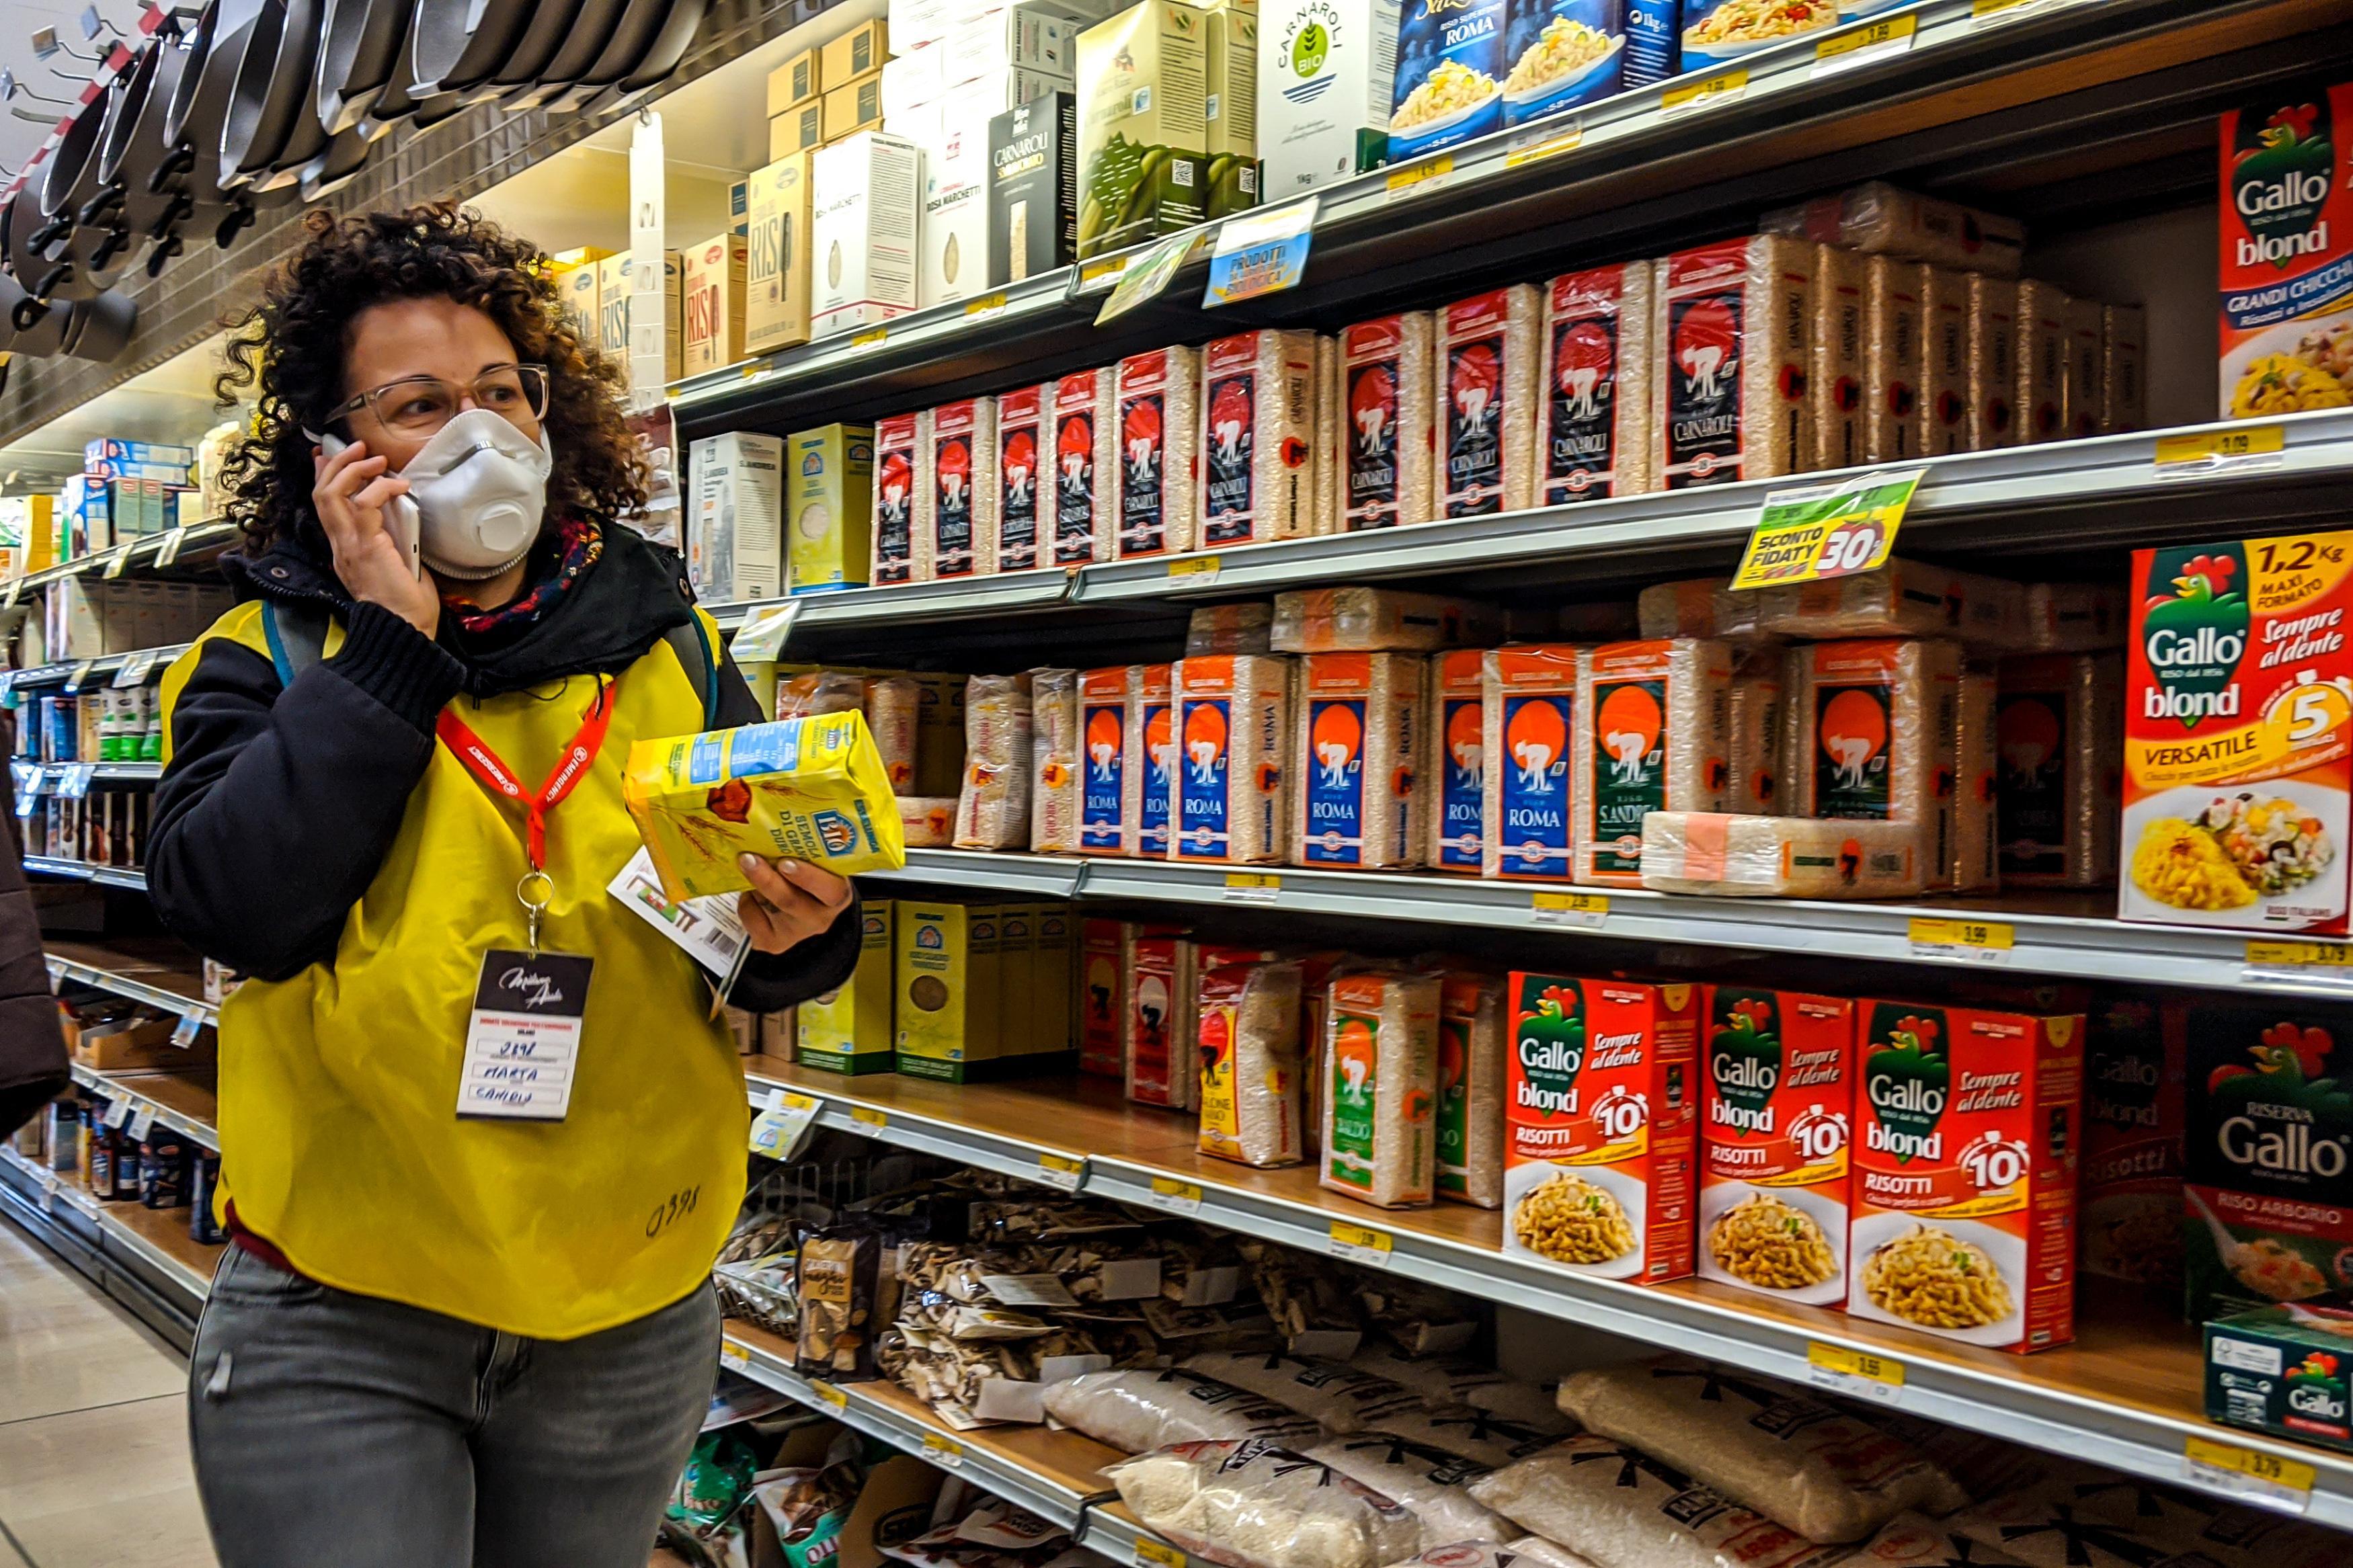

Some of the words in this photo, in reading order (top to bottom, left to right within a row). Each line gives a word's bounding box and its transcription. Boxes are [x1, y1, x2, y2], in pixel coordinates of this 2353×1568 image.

[1278, 2, 1343, 69] CARNAROLI
[1445, 16, 1494, 46] ROMA
[1298, 54, 1323, 73] BIO
[994, 132, 1048, 167] CARNAROLI
[2237, 171, 2327, 215] Gallo
[2236, 220, 2327, 267] blond
[2227, 286, 2288, 313] GRANDI
[1749, 542, 1819, 568] FIDATY
[1757, 526, 1824, 551] SCONTO
[2257, 540, 2316, 575] 1,2
[2258, 578, 2323, 608] FORMATO
[2259, 574, 2303, 594] MAXI
[2260, 608, 2344, 644] Sempre
[2147, 626, 2243, 667] Gallo
[2259, 641, 2281, 669] al
[2281, 632, 2344, 664] dente
[2145, 683, 2240, 718] blond
[2288, 690, 2330, 740] 5
[1265, 706, 1275, 751] ROMA
[1400, 707, 1410, 754] ROMA
[2145, 731, 2258, 766] VERSATILE
[545, 758, 580, 803] EMERGENCY
[780, 811, 793, 826] DI
[1087, 795, 1117, 810] ROMA
[1185, 798, 1222, 815] ROMA
[1312, 802, 1355, 819] ROMA
[1509, 809, 1561, 828] ROMA
[770, 827, 793, 854] DURO
[795, 815, 822, 859] SEMOLA
[818, 817, 847, 852] BIO
[1519, 1037, 1580, 1073] Gallo
[1593, 1032, 1642, 1051] Sempre
[1606, 1048, 1643, 1068] dente
[1790, 1048, 1840, 1069] Sempre
[483, 1066, 539, 1081] MARTA
[1713, 1053, 1777, 1090] Gallo
[1804, 1067, 1841, 1086] dente
[1958, 1071, 2022, 1094] Sempre
[1517, 1080, 1579, 1113] blond
[1869, 1074, 1944, 1115] Gallo
[1975, 1089, 2023, 1109] dente
[1600, 1102, 1642, 1137] 10
[1711, 1098, 1774, 1132] blond
[2246, 1102, 2315, 1124] RISERVA
[1515, 1126, 1570, 1145] RISOTTI
[1796, 1122, 1841, 1157] 10
[1866, 1122, 1942, 1160] blond
[2219, 1116, 2347, 1178] Gallo
[1710, 1145, 1767, 1164] RISOTTI
[1968, 1150, 2021, 1188] 10
[1864, 1173, 1933, 1194] RISOTTI
[2219, 1192, 2257, 1212] RISO
[2259, 1199, 2343, 1226] ARBORIO
